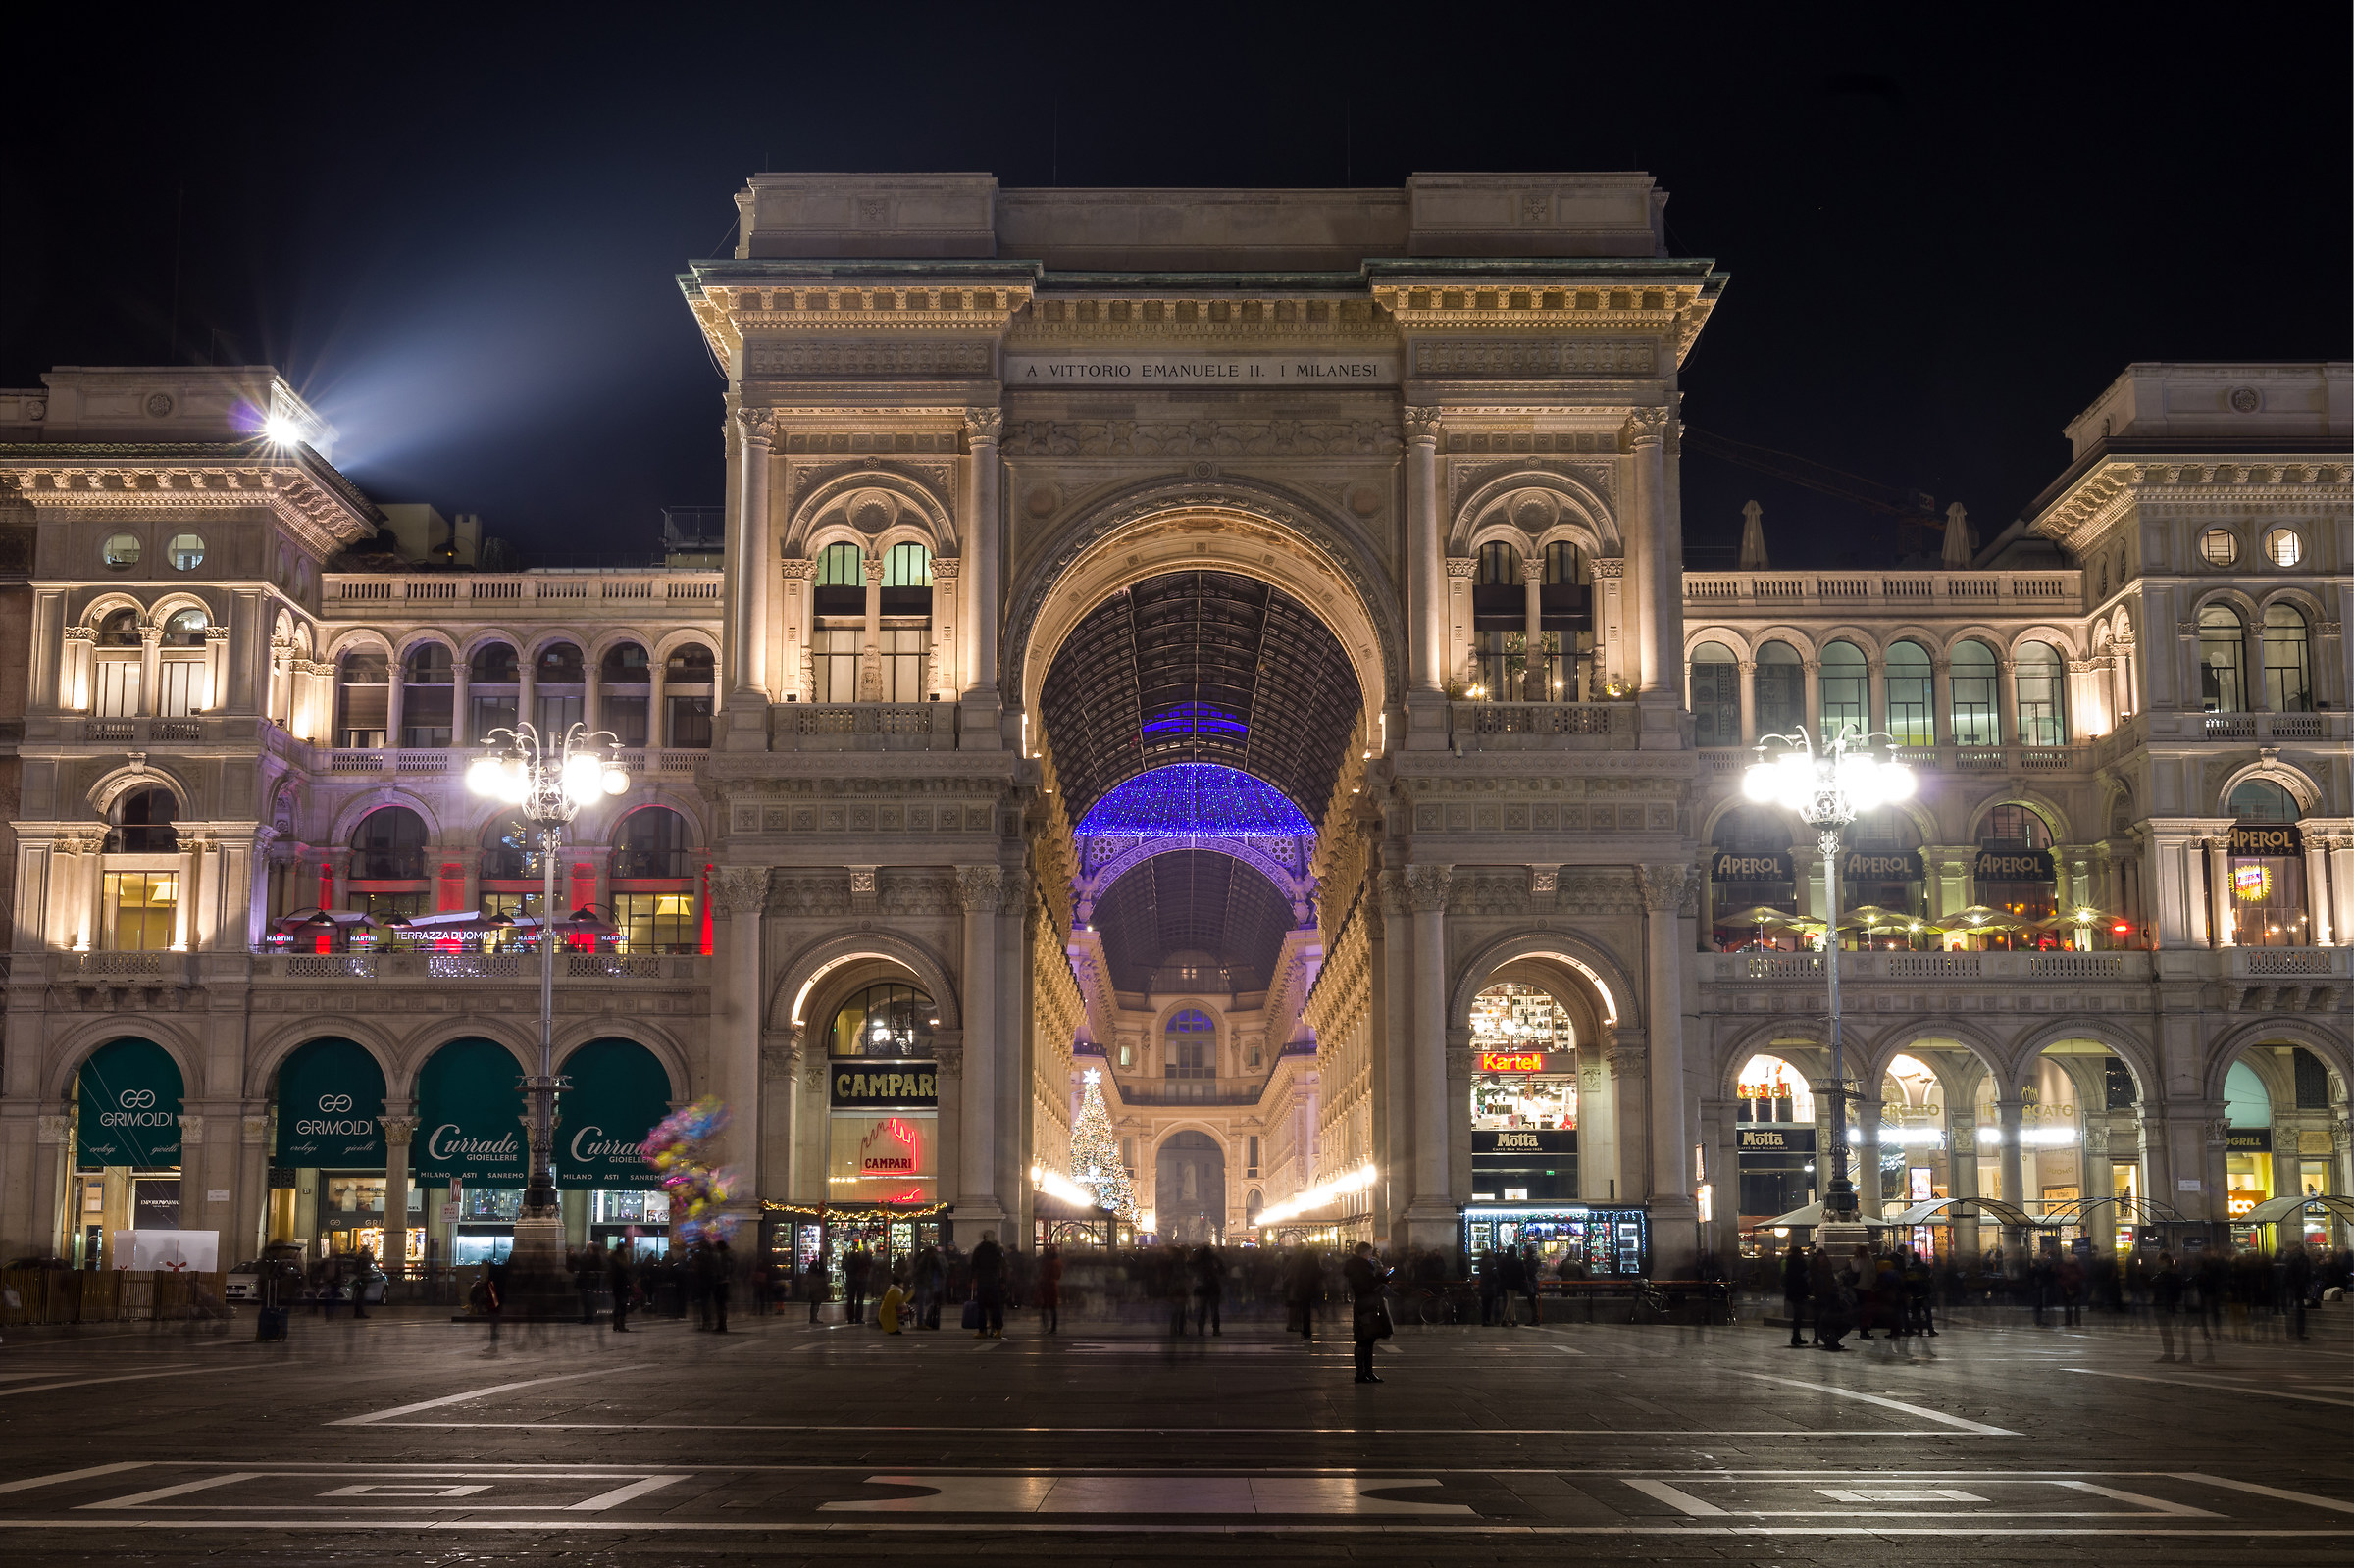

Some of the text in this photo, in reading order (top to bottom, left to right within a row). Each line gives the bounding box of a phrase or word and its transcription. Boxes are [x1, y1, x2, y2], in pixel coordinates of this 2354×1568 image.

[1027, 364, 1038, 378] A
[1049, 364, 1131, 378] VITTORIO
[1142, 364, 1239, 378] EMANUELE
[1280, 364, 1285, 378] I
[1296, 364, 1377, 378] MILANESI
[1718, 854, 1782, 874] APEROL
[1848, 853, 1913, 873] APEROL
[1978, 853, 2043, 874] APEROL
[394, 931, 449, 940] TERRAZZA
[451, 931, 490, 940] DUOMO
[1482, 1053, 1542, 1070] Kartell
[1881, 1104, 1940, 1116] ERCATO
[2021, 1104, 2074, 1117] RCATO
[99, 1112, 173, 1127] GRIMOLDI
[296, 1120, 373, 1135] GRIMOLDI
[428, 1123, 520, 1160] Currado
[1497, 1133, 1539, 1147] Motta
[1742, 1132, 1784, 1146] Motta
[2226, 1138, 2262, 1146] OGRILL
[89, 1142, 179, 1156] orologi gioielli
[289, 1140, 377, 1156] orologi gioielli
[865, 1158, 912, 1169] CAMPARI
